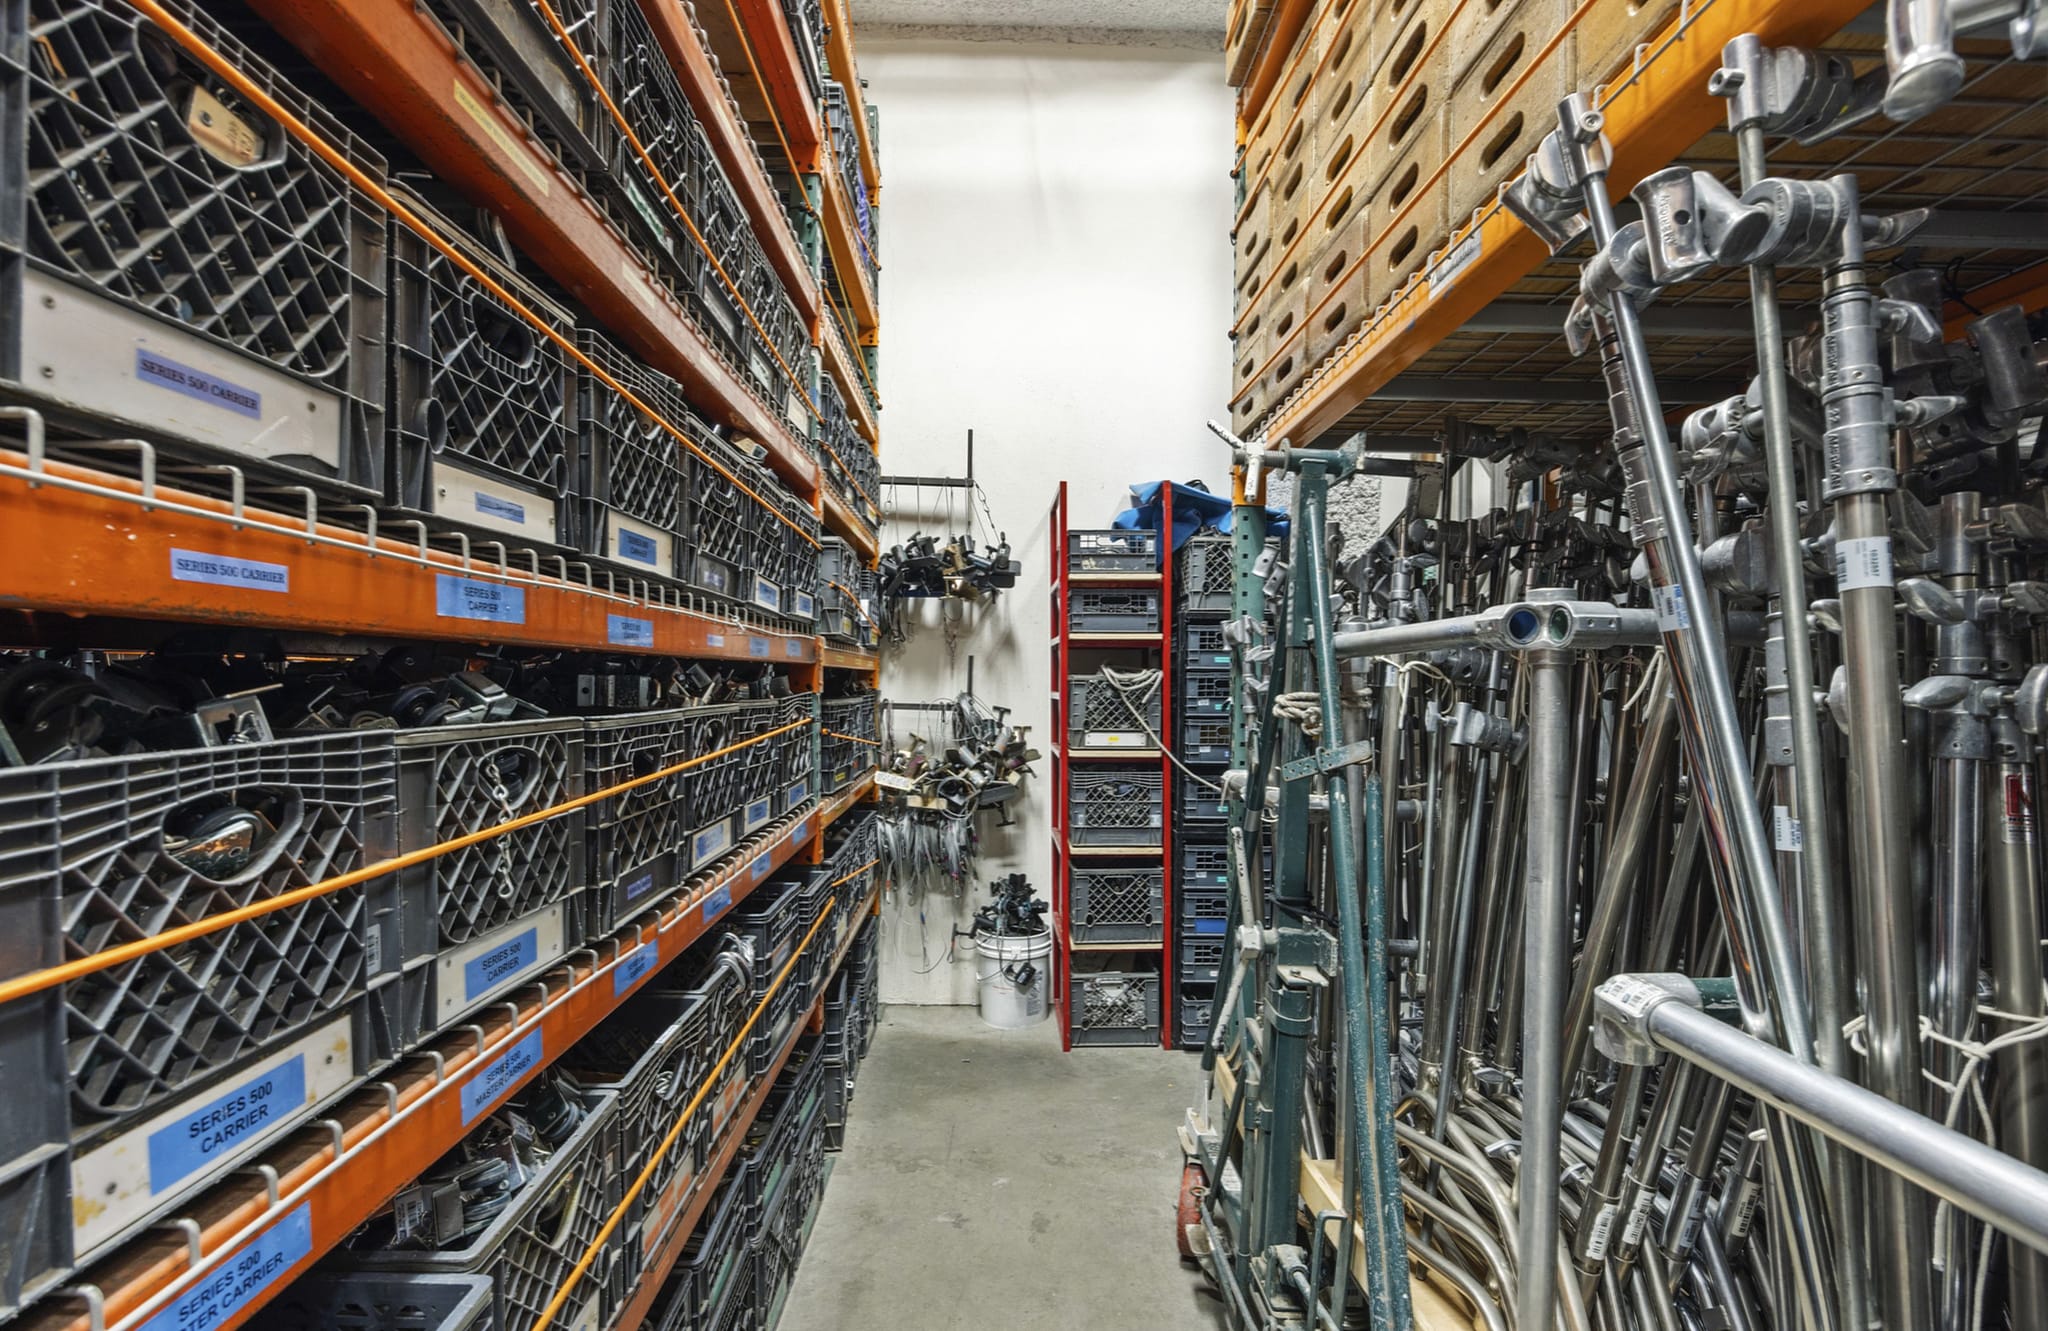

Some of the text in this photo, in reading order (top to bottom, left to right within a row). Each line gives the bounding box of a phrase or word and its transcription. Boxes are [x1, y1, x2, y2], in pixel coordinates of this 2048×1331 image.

[140, 358, 186, 385] SERIES
[210, 383, 259, 411] CARRIER
[176, 558, 218, 576] SERIES
[240, 567, 286, 585] CARRIER
[482, 948, 509, 972] SERIES
[487, 956, 520, 983] CARRIER
[189, 1080, 273, 1139] SERIES 500
[201, 1103, 269, 1154] CARRIER
[178, 1250, 261, 1323] SERIES 500
[180, 1251, 284, 1331] TER CARRIER
